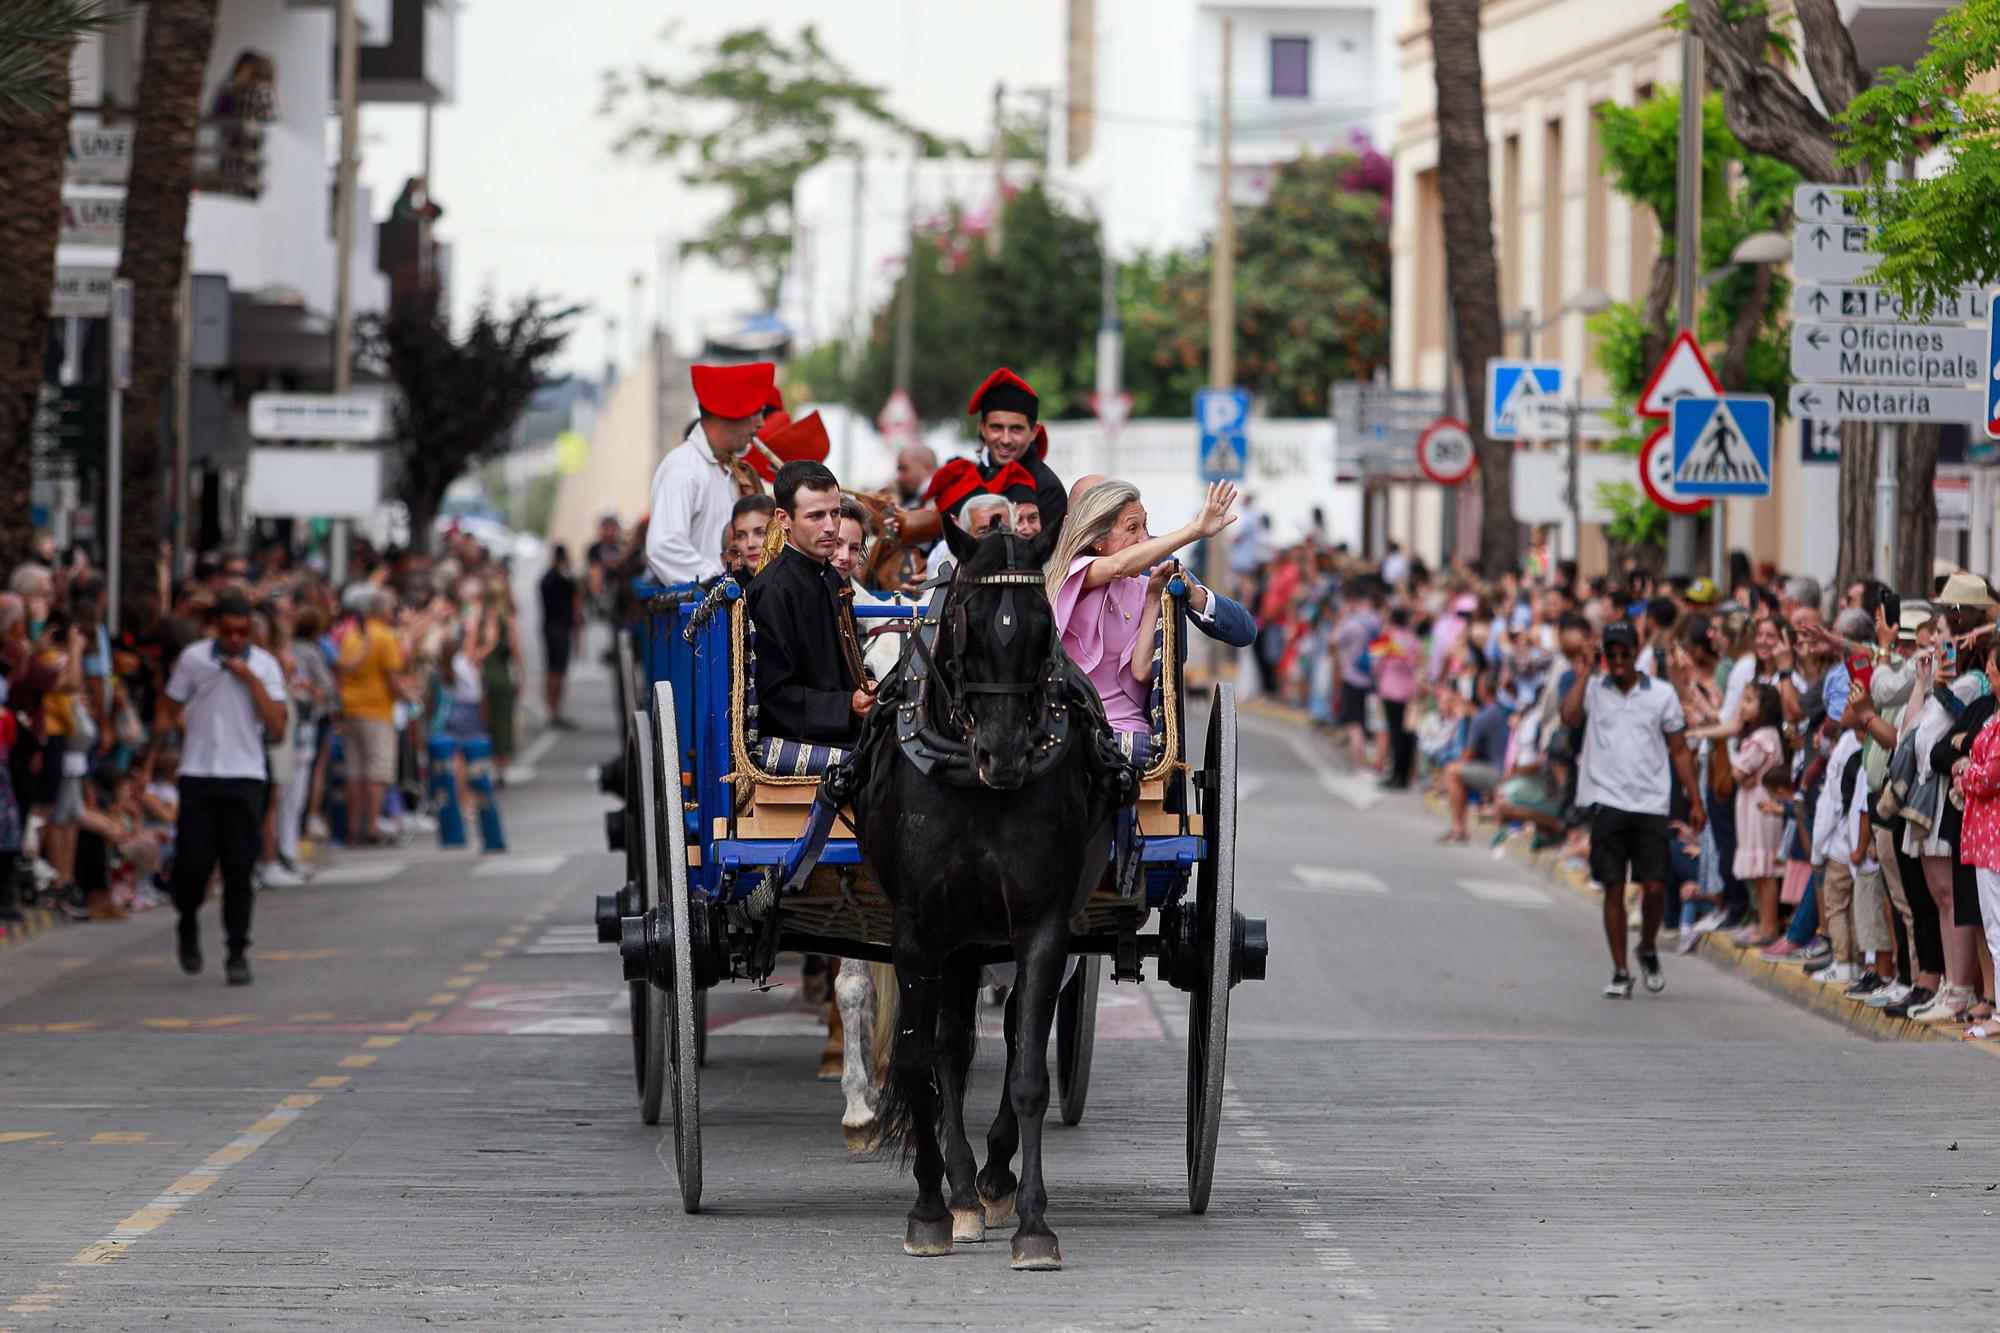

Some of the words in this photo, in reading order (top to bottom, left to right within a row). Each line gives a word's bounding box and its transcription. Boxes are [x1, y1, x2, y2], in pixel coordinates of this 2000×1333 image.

[1840, 325, 1944, 352] Oficines
[1839, 351, 1979, 383] Municipals
[1836, 388, 1931, 415] Notaria
